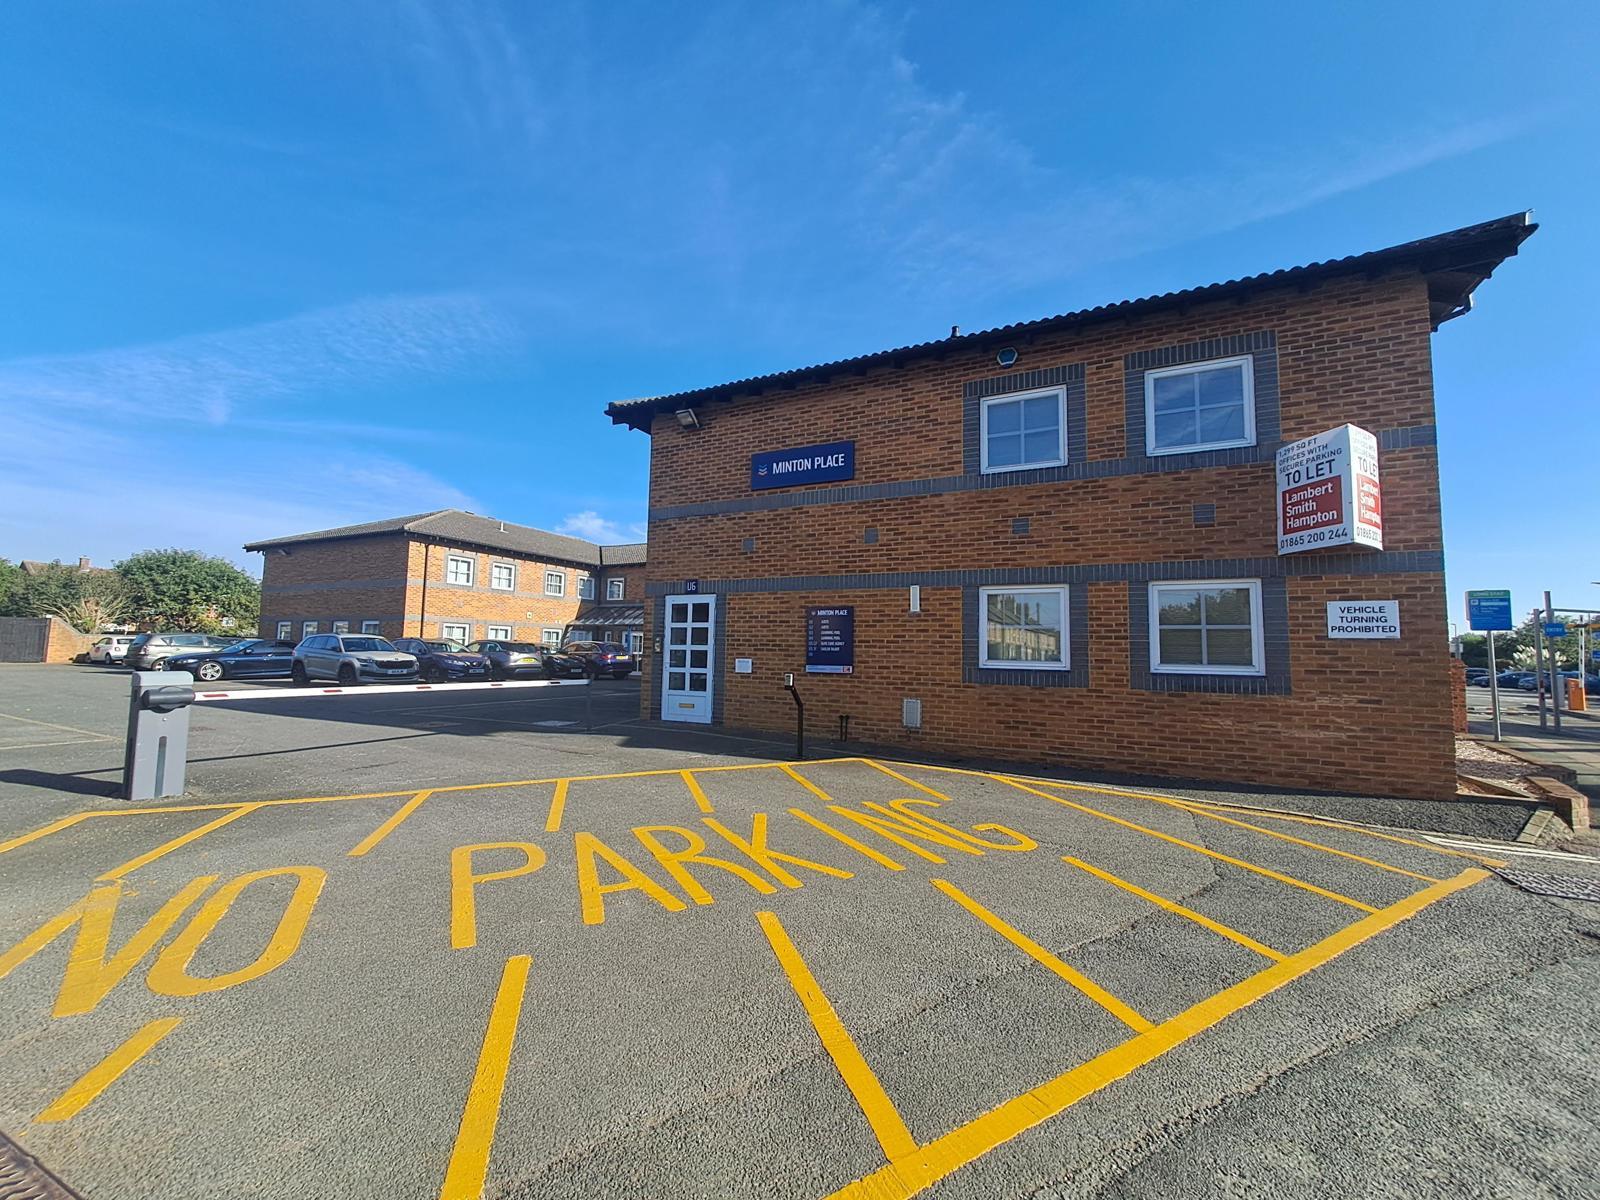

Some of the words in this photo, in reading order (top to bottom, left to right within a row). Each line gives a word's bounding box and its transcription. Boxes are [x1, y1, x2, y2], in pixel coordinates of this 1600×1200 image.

[1278, 451, 1306, 466] OFFICES
[1307, 444, 1328, 455] WITH
[1279, 447, 1295, 457] 1,299
[1296, 442, 1306, 451] SQ
[1307, 438, 1318, 446] FT
[772, 458, 811, 474] MINTON
[814, 453, 845, 469] PLACE
[1279, 460, 1305, 473] SECURE
[1305, 448, 1342, 464] PARKING
[1358, 456, 1368, 474] TO
[1285, 470, 1301, 486] TO
[1306, 459, 1335, 480] LET
[1286, 482, 1333, 504] Lambert
[1286, 500, 1316, 516] Smith
[1286, 510, 1337, 529] Hampton
[1280, 535, 1305, 549] 01865
[1307, 532, 1325, 543] 200
[1329, 527, 1348, 540] 244
[687, 581, 696, 591] U6
[1331, 625, 1397, 633] PROHIBITED
[0, 865, 328, 1018] NO
[449, 798, 1038, 949] PARKING
